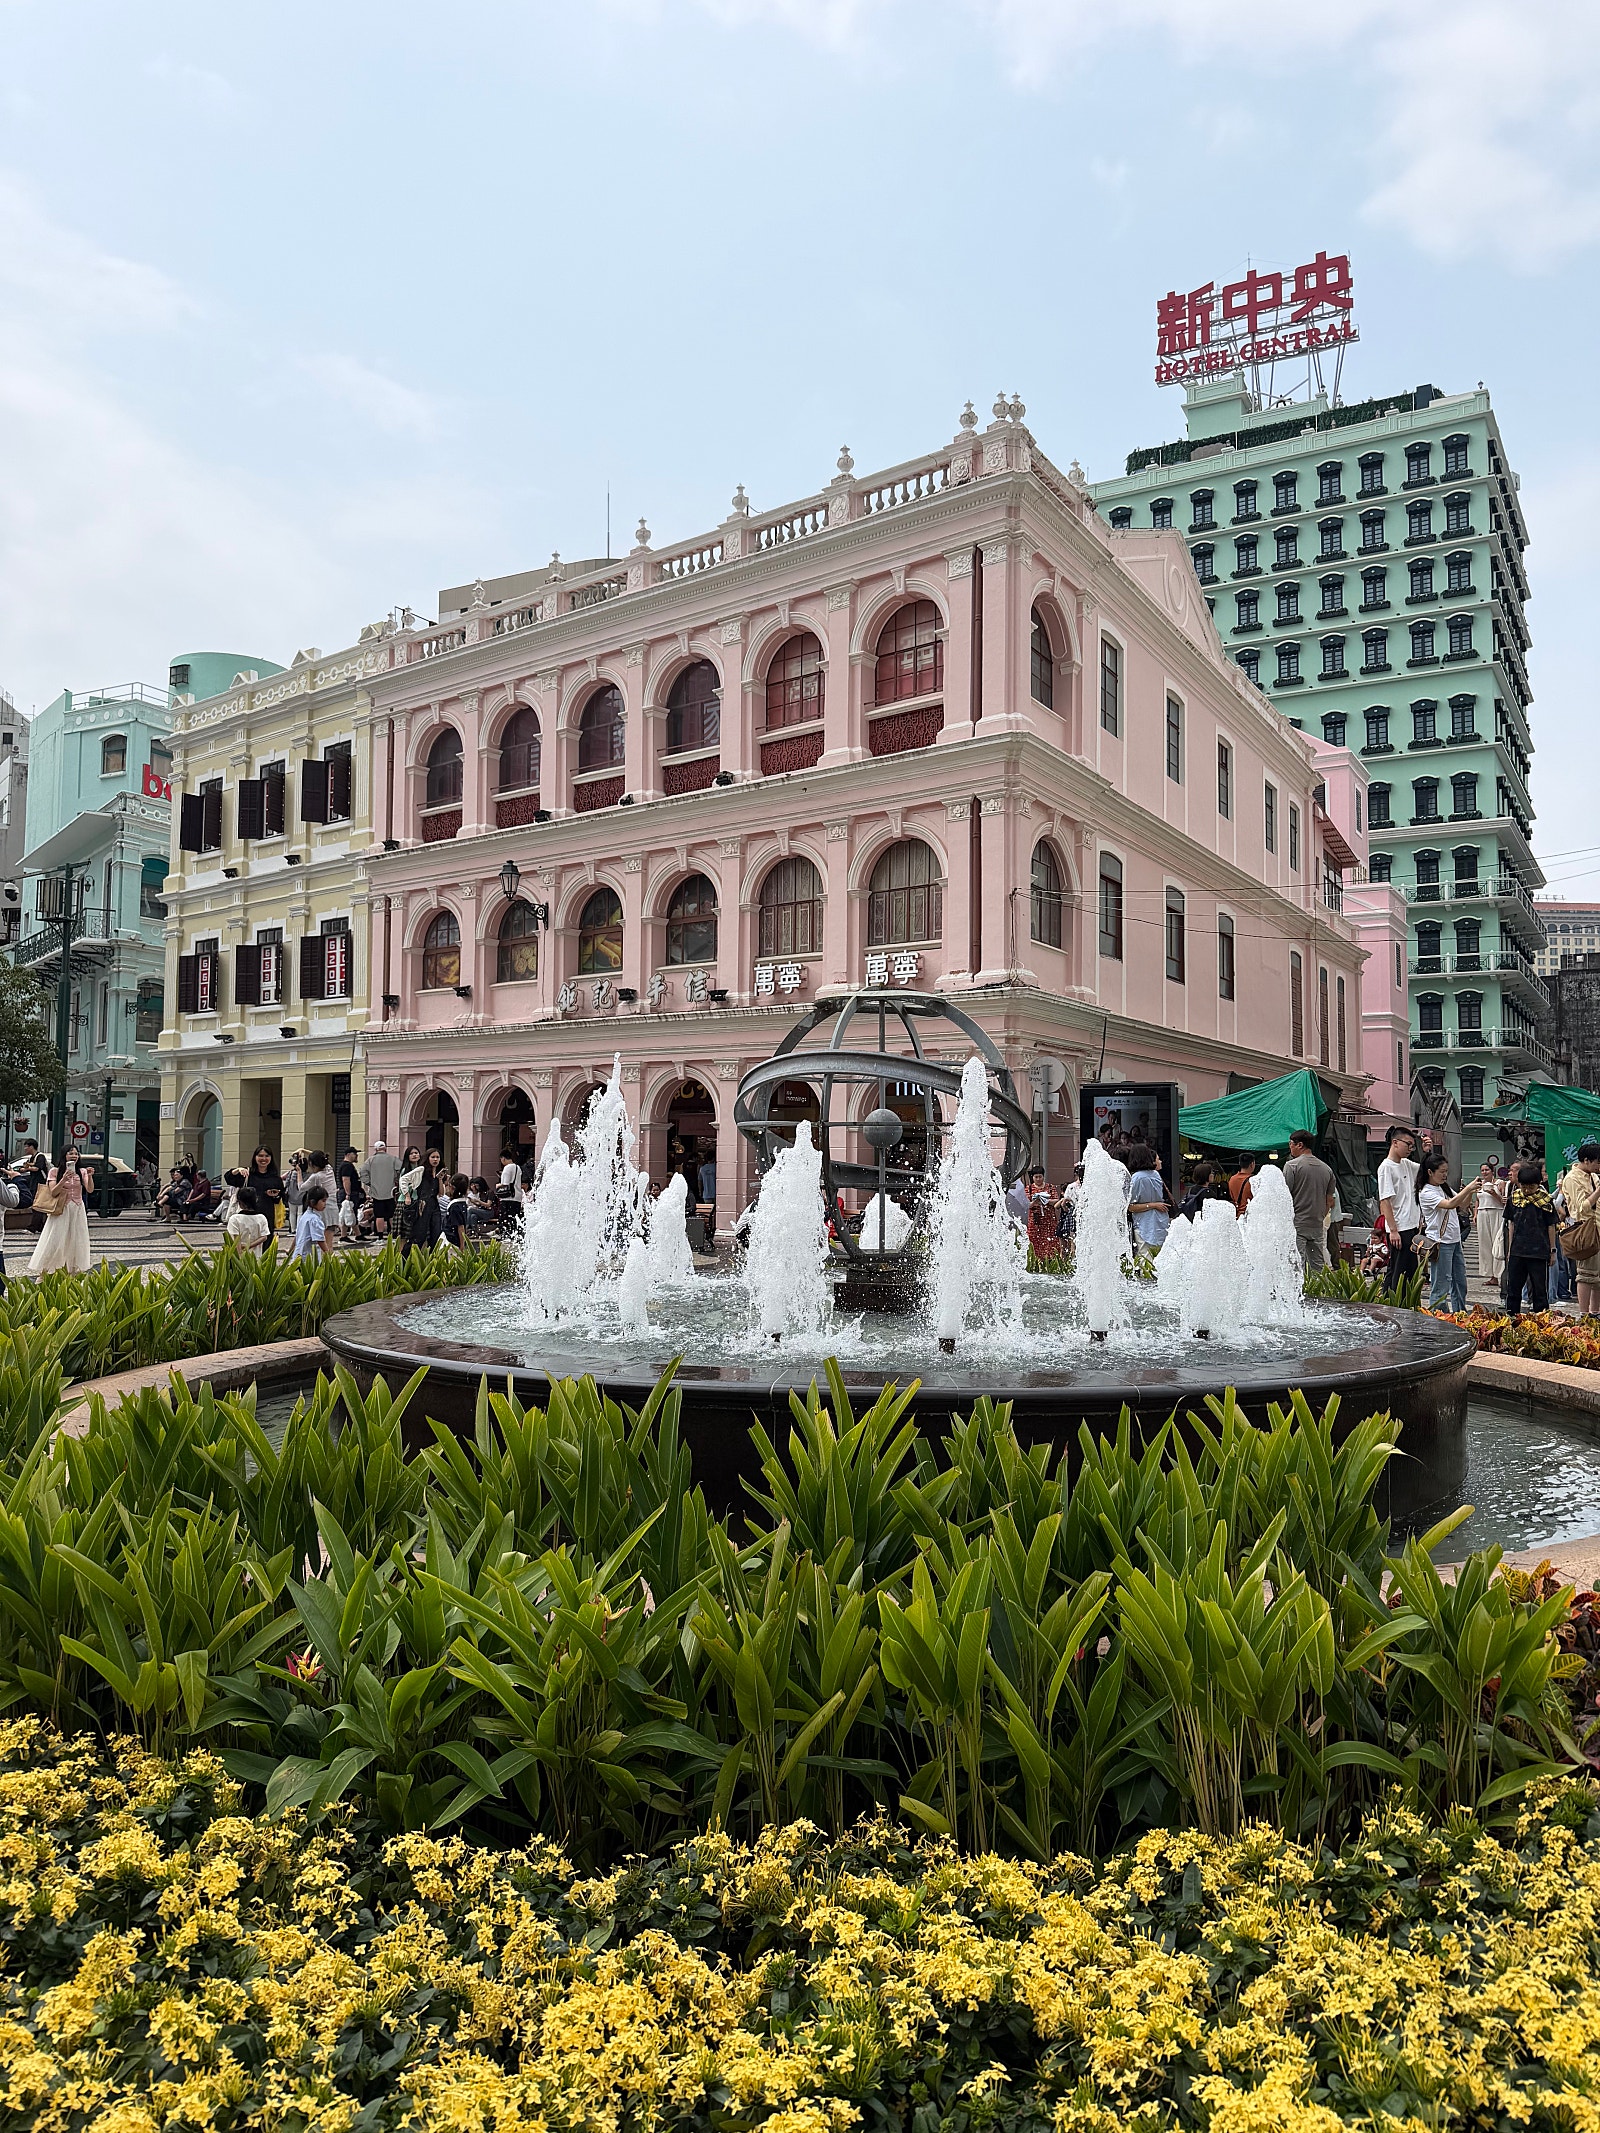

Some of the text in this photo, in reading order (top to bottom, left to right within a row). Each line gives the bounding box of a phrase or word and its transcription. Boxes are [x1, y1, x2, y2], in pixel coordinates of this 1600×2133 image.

[1156, 250, 1353, 355] 新中央
[1155, 320, 1358, 382] HOTEL CENTRAL
[753, 961, 802, 997] 萬寧
[864, 949, 919, 988] 萬寧
